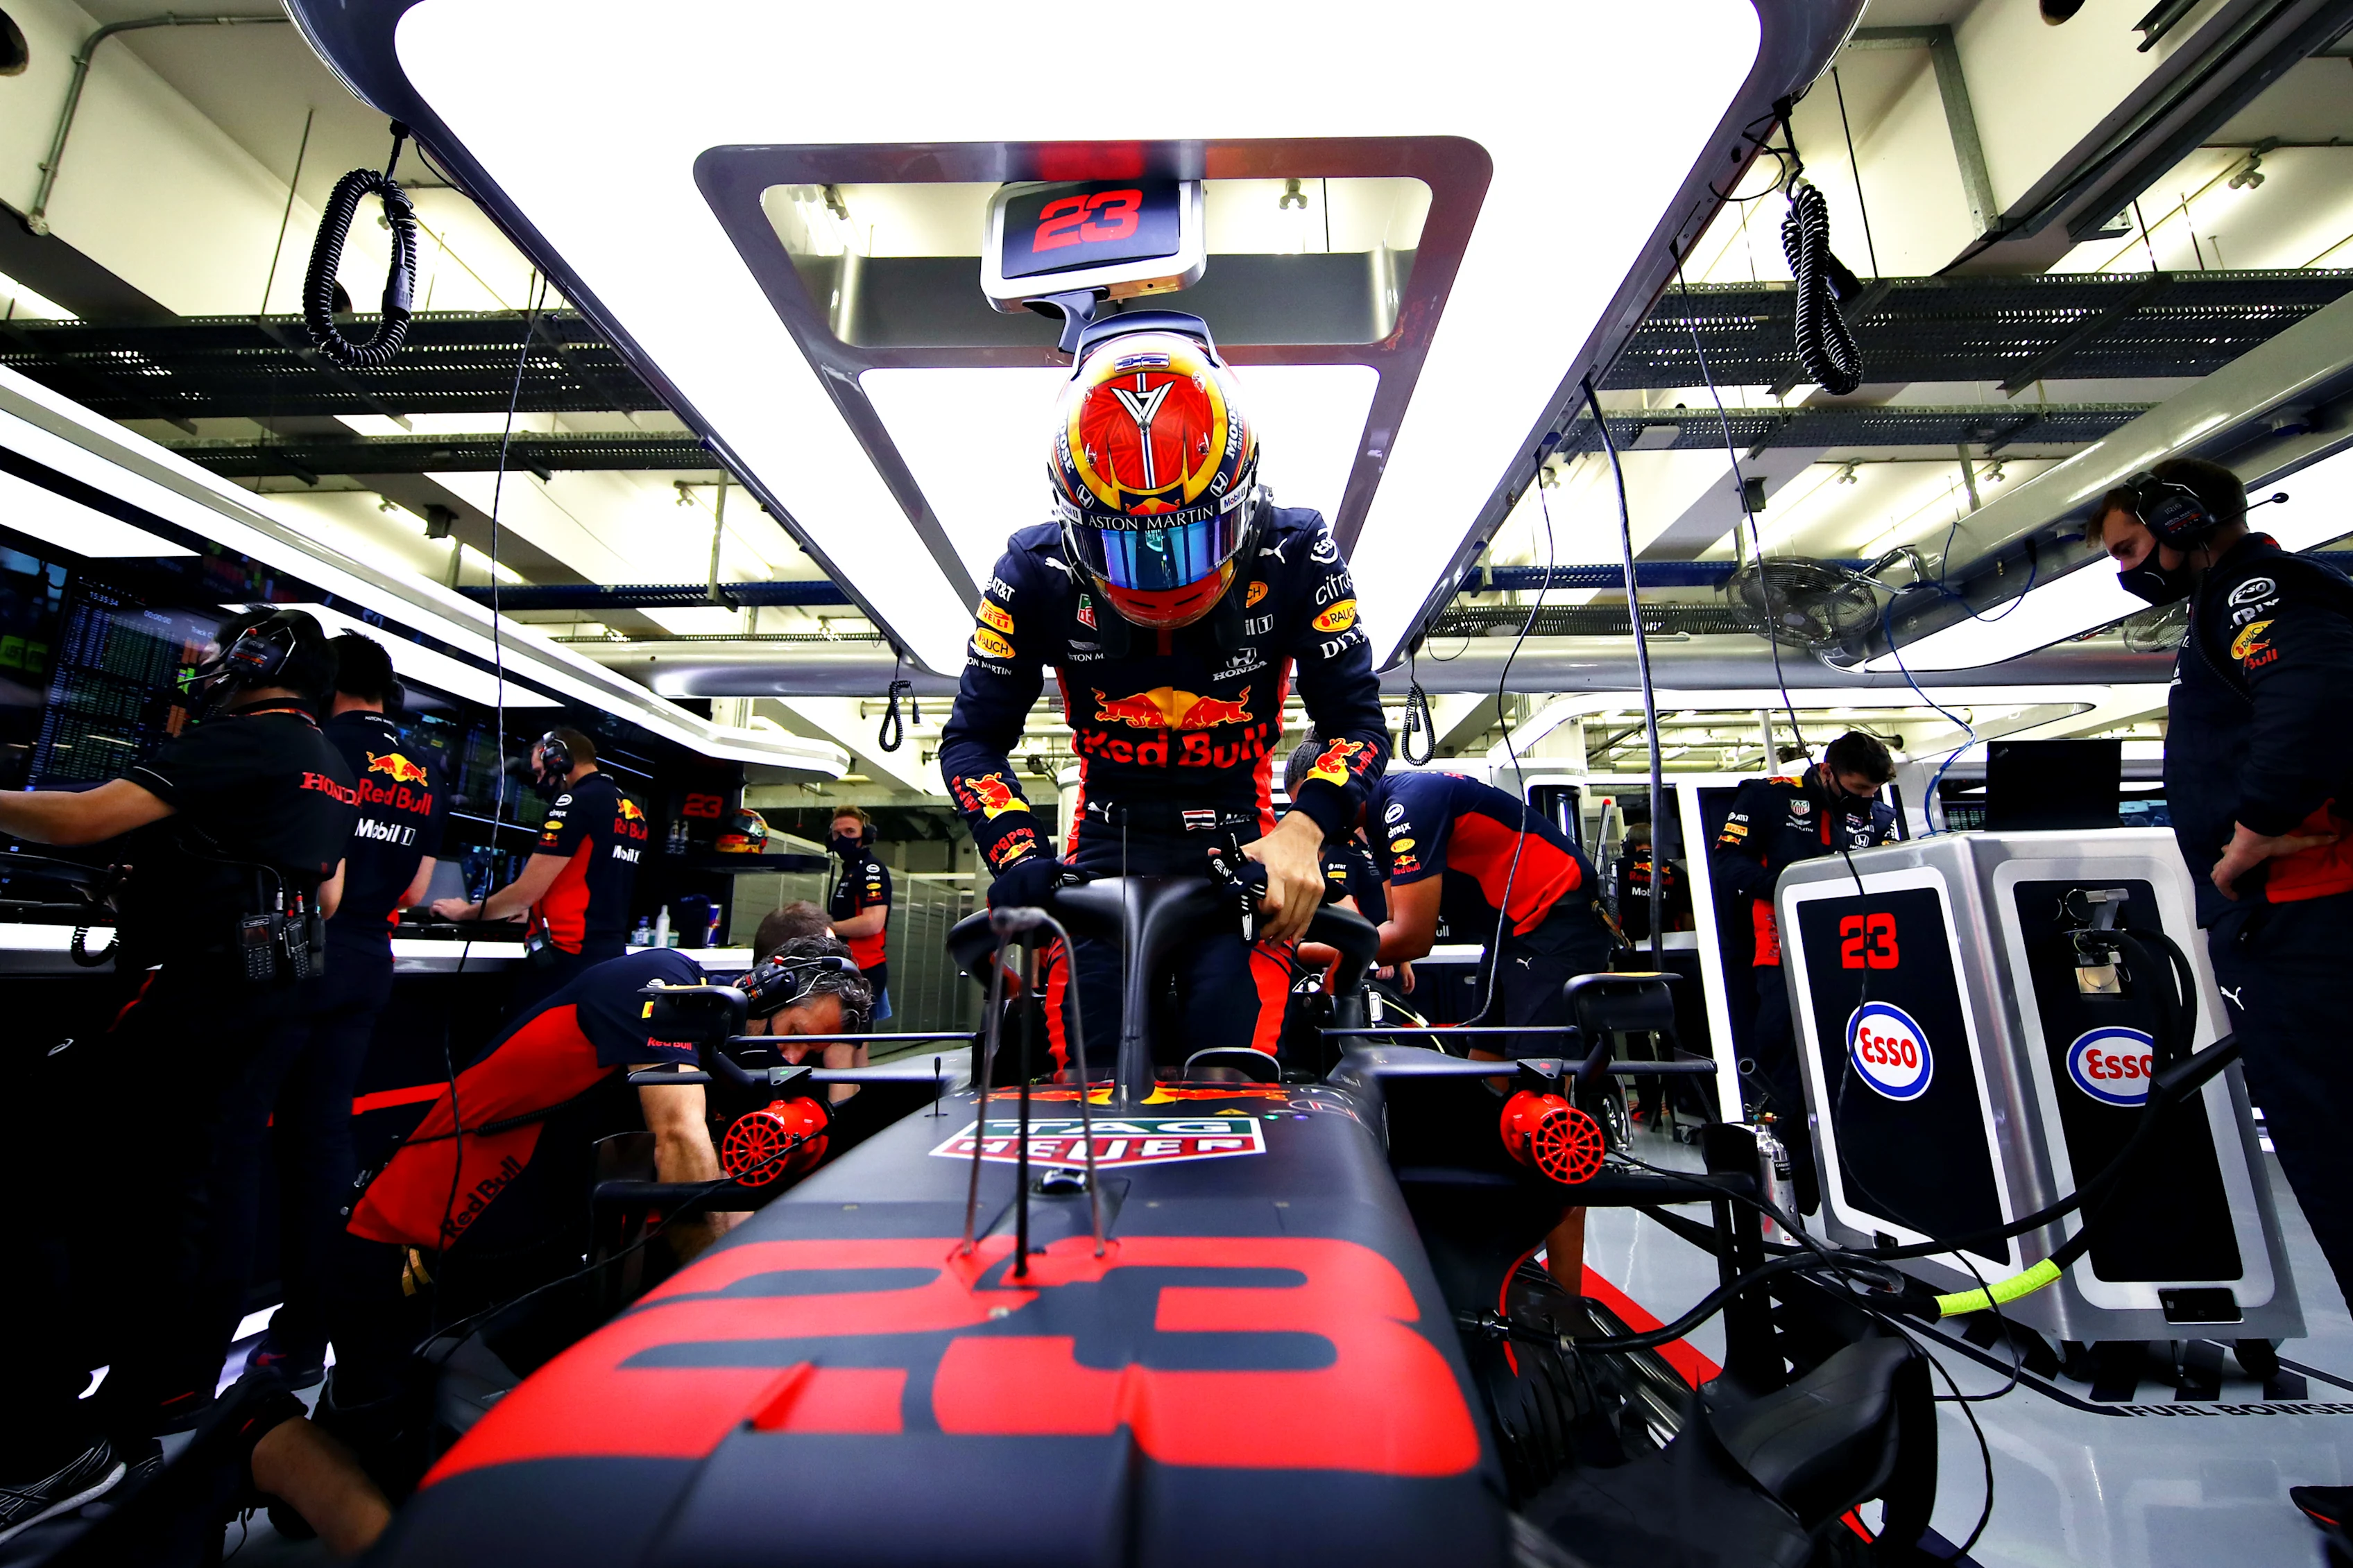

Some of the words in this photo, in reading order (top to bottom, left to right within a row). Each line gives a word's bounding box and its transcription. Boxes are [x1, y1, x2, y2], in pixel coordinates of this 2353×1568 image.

[1032, 188, 1143, 253] 23
[1224, 490, 1240, 508] Mobil
[1088, 515, 1138, 531] ASTON
[1147, 505, 1213, 530] MARTIN
[990, 576, 1016, 602] AT&T
[1213, 660, 1268, 682] HONDA
[1082, 728, 1168, 768] Red
[1178, 723, 1267, 768] Bull
[359, 777, 398, 806] Red
[395, 786, 433, 816] Bull
[681, 793, 724, 819] 23
[354, 817, 402, 843] Mobil
[1006, 827, 1036, 845] Red
[988, 836, 1012, 863] Bull
[1393, 865, 1406, 875] Red
[1405, 862, 1421, 872] Bull
[1661, 876, 1675, 886] ull
[1839, 913, 1899, 970] 23
[991, 1121, 1232, 1134] TAG
[958, 1138, 1243, 1162] HEUER
[439, 1192, 485, 1239] Red
[476, 1155, 522, 1200] Bull
[418, 1237, 1480, 1479] 23
[2128, 1404, 2221, 1417] FUEL
